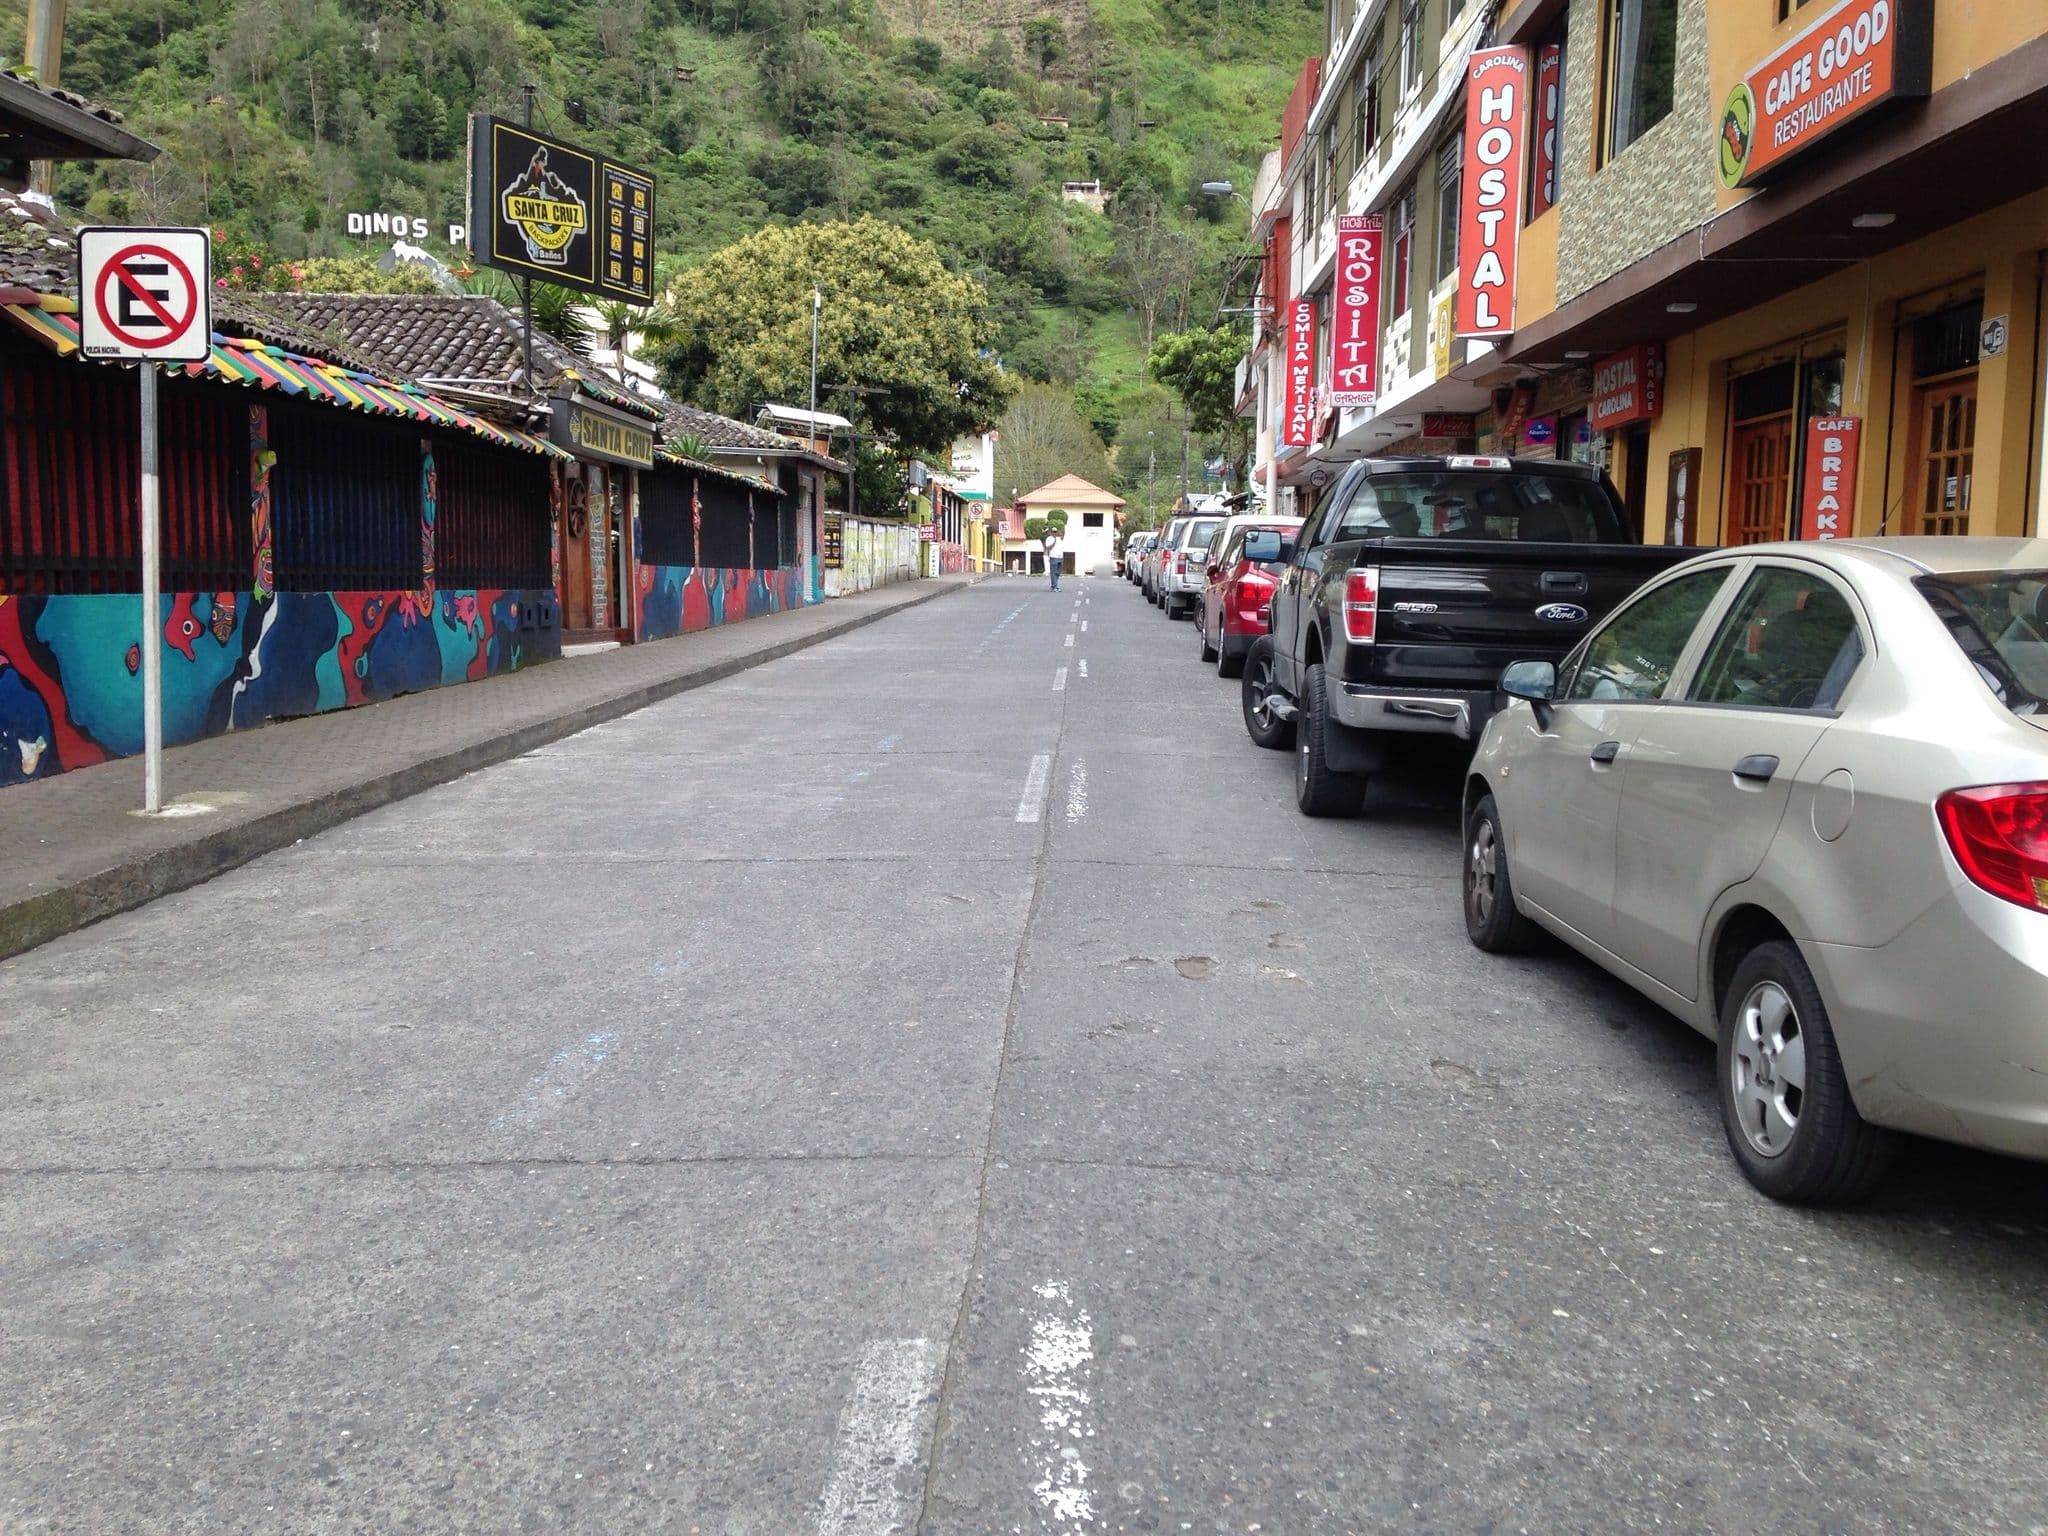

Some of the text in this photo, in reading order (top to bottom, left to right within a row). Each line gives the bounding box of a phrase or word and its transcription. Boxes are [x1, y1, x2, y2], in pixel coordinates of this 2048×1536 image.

[1472, 56, 1525, 80] CAROLINA
[1765, 0, 1889, 116] CAFE GOOD
[1773, 61, 1873, 149] RESTAURANTE
[514, 199, 579, 224] SANTA CRUZ
[1470, 83, 1515, 329] HOSTAL
[347, 212, 429, 239] DINOS
[1341, 216, 1383, 229] HOSTAL
[539, 249, 562, 260] Baños
[1291, 303, 1310, 442] COMIDA MEXICANA
[1595, 357, 1637, 397] HOSTAL
[1334, 394, 1374, 405] GARAGE
[1597, 391, 1633, 419] CAROLINA
[583, 417, 652, 461] SANTA CRUZ
[1816, 420, 1853, 431] CAFE
[1547, 606, 1576, 619] Ford
